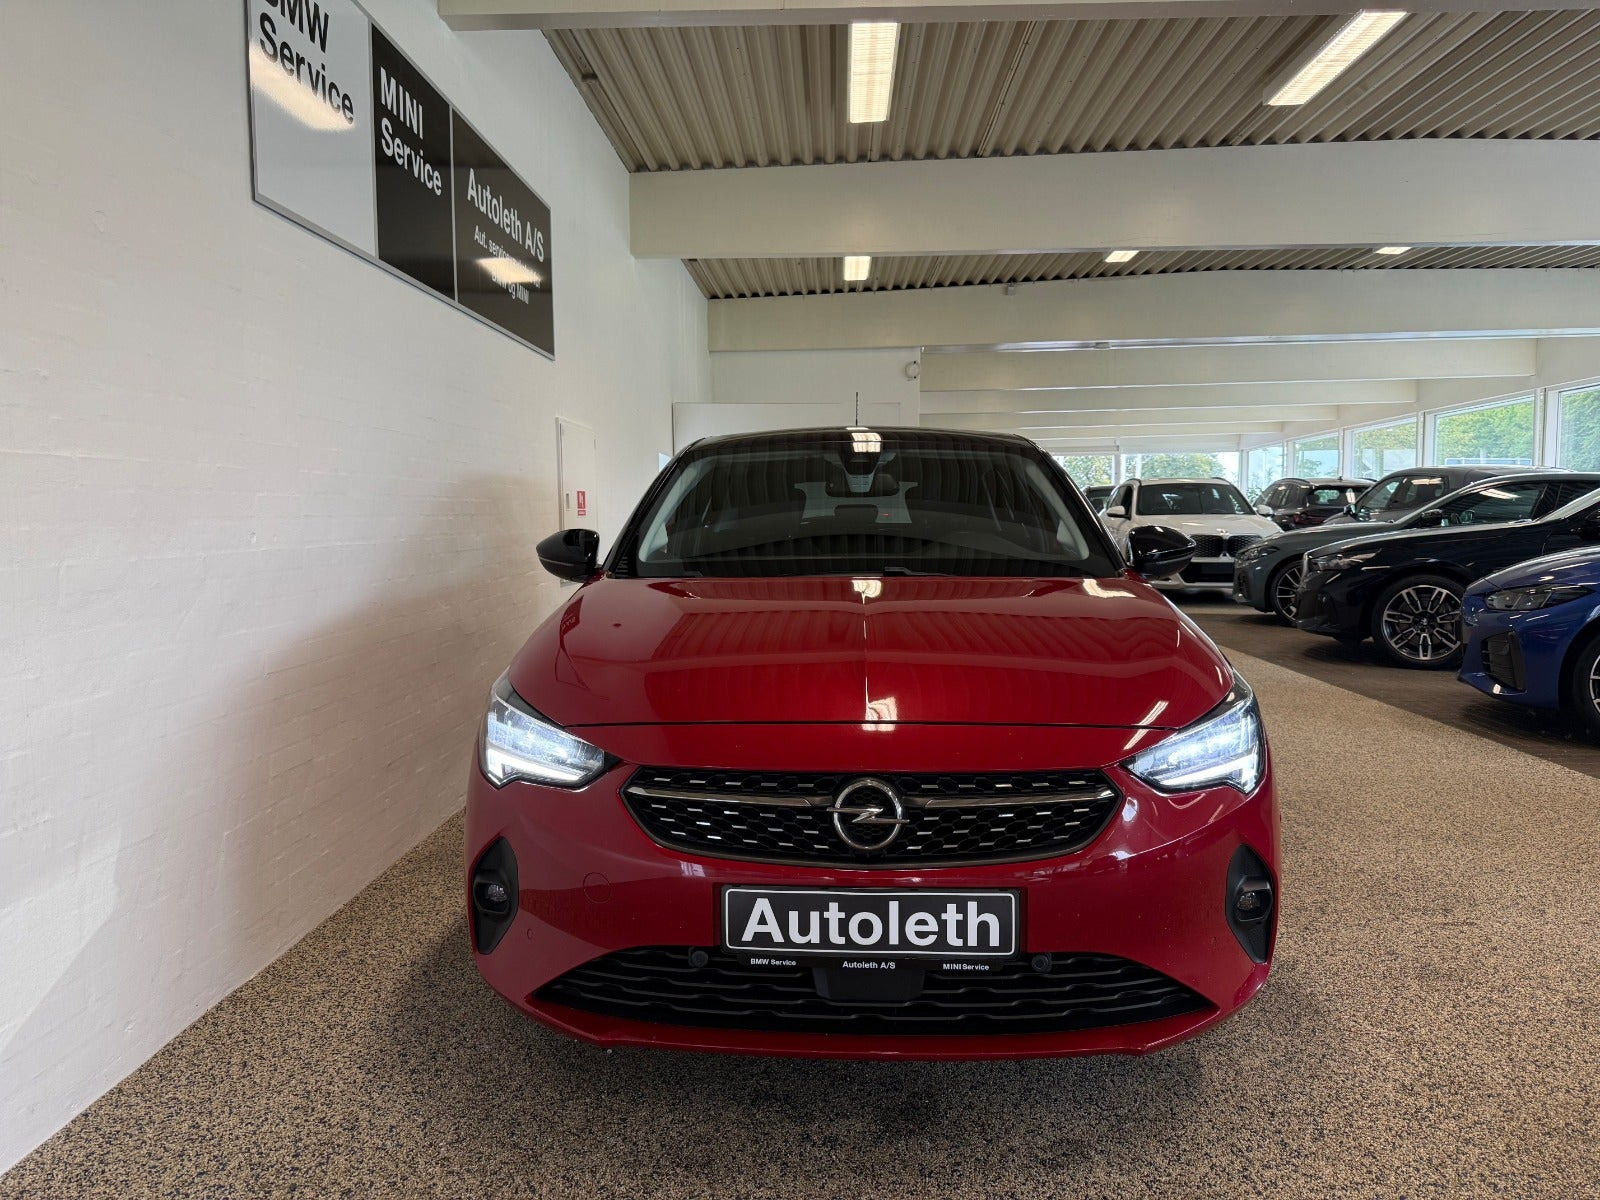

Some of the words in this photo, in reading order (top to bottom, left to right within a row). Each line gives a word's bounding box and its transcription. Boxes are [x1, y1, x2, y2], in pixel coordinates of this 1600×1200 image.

[265, 0, 329, 53] MW
[260, 12, 354, 125] Service
[380, 66, 423, 140] MINI
[381, 117, 442, 196] Service
[467, 167, 522, 245] Autoleth
[525, 221, 545, 263] A/S
[474, 225, 488, 249] Aut.
[741, 897, 1000, 947] Autoleth
[842, 960, 878, 969] Autoleth
[880, 961, 896, 970] A/S
[962, 963, 990, 971] Service
